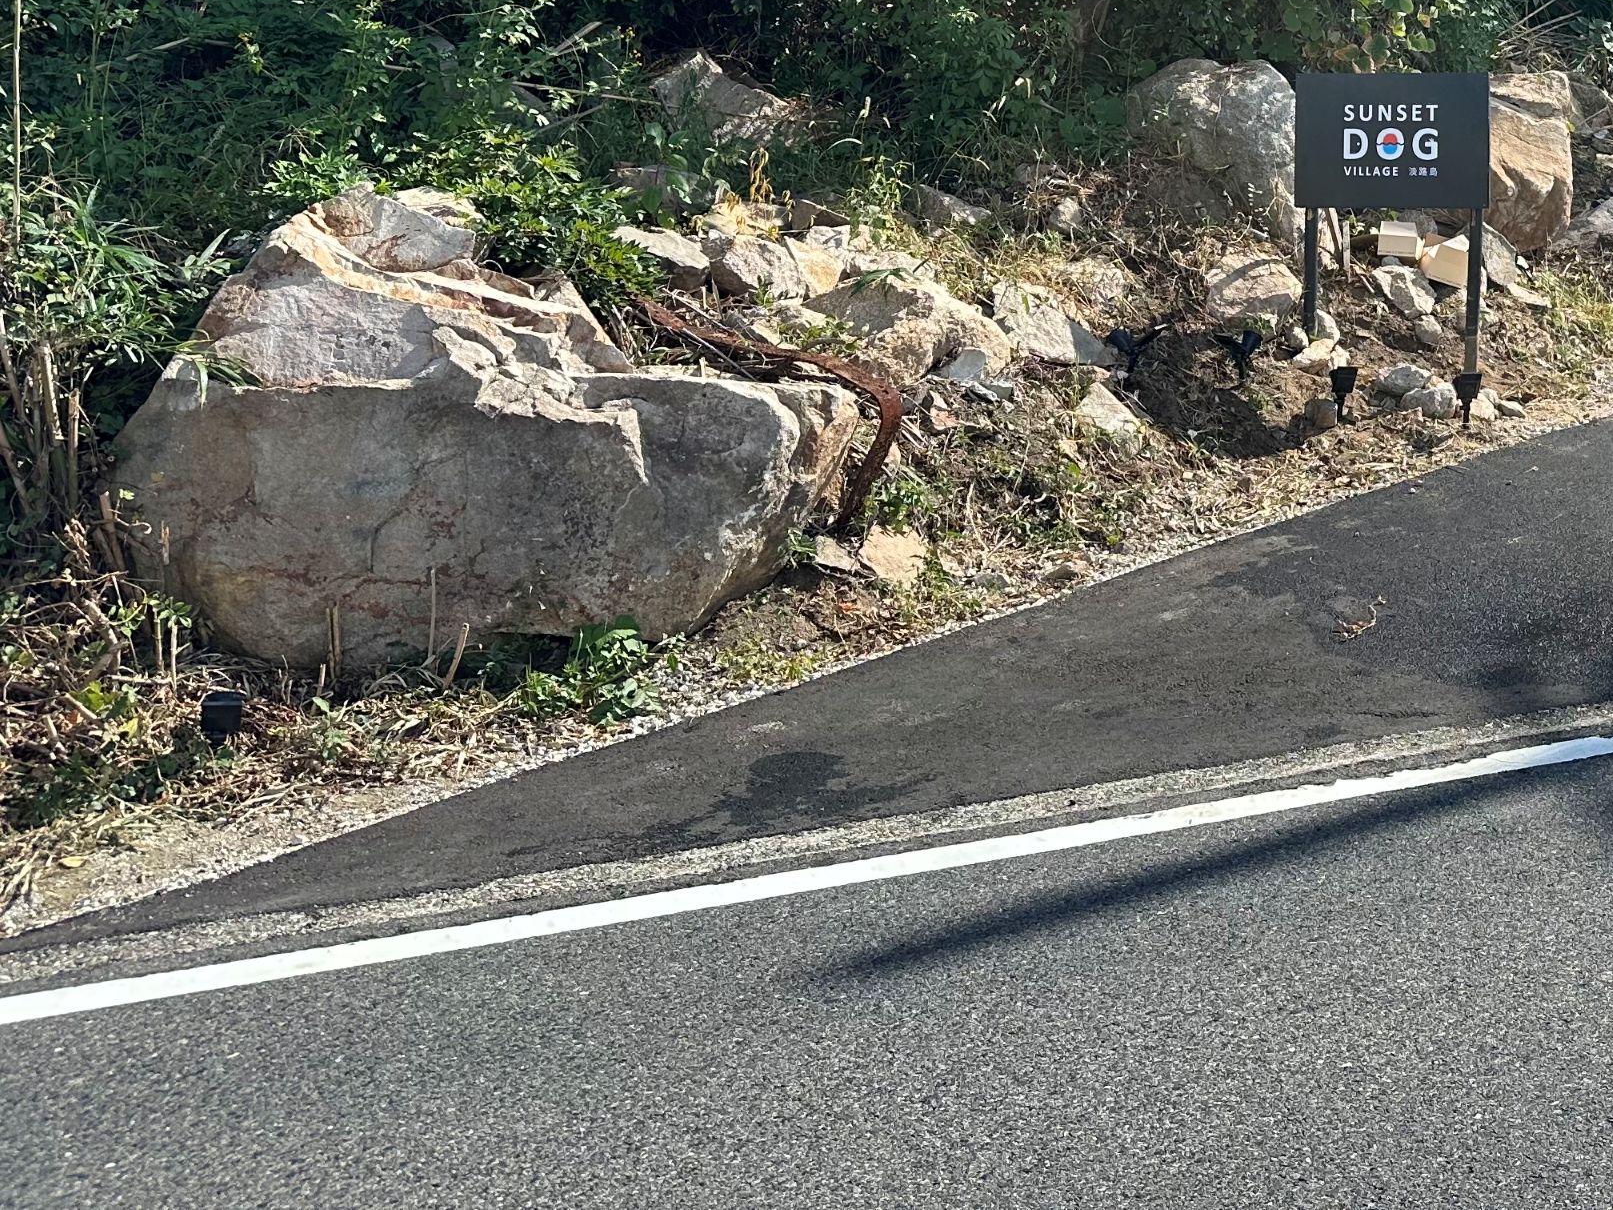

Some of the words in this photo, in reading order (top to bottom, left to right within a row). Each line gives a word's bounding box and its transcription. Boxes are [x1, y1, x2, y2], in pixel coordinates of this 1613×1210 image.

[1343, 104, 1439, 122] SUNSET
[1343, 127, 1439, 161] DOG
[1343, 165, 1399, 177] VILLAGE
[1408, 166, 1438, 177] 淡路島
